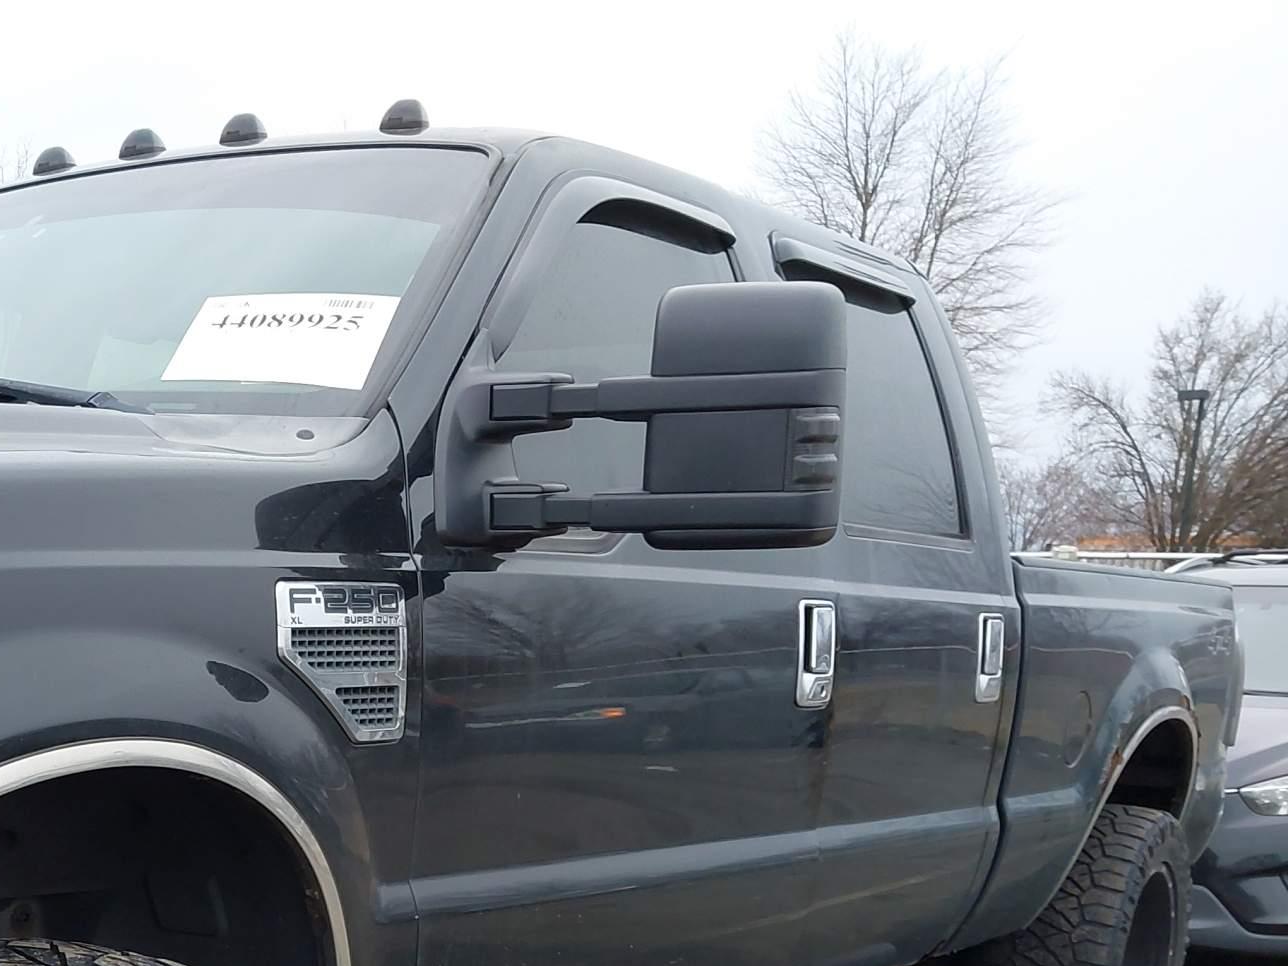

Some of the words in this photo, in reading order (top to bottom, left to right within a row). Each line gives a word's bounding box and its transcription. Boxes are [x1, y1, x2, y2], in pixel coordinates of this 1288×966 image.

[211, 313, 364, 331] 44089925
[289, 587, 400, 614] F-250
[344, 616, 374, 625] SUPER
[376, 616, 400, 625] DUTY
